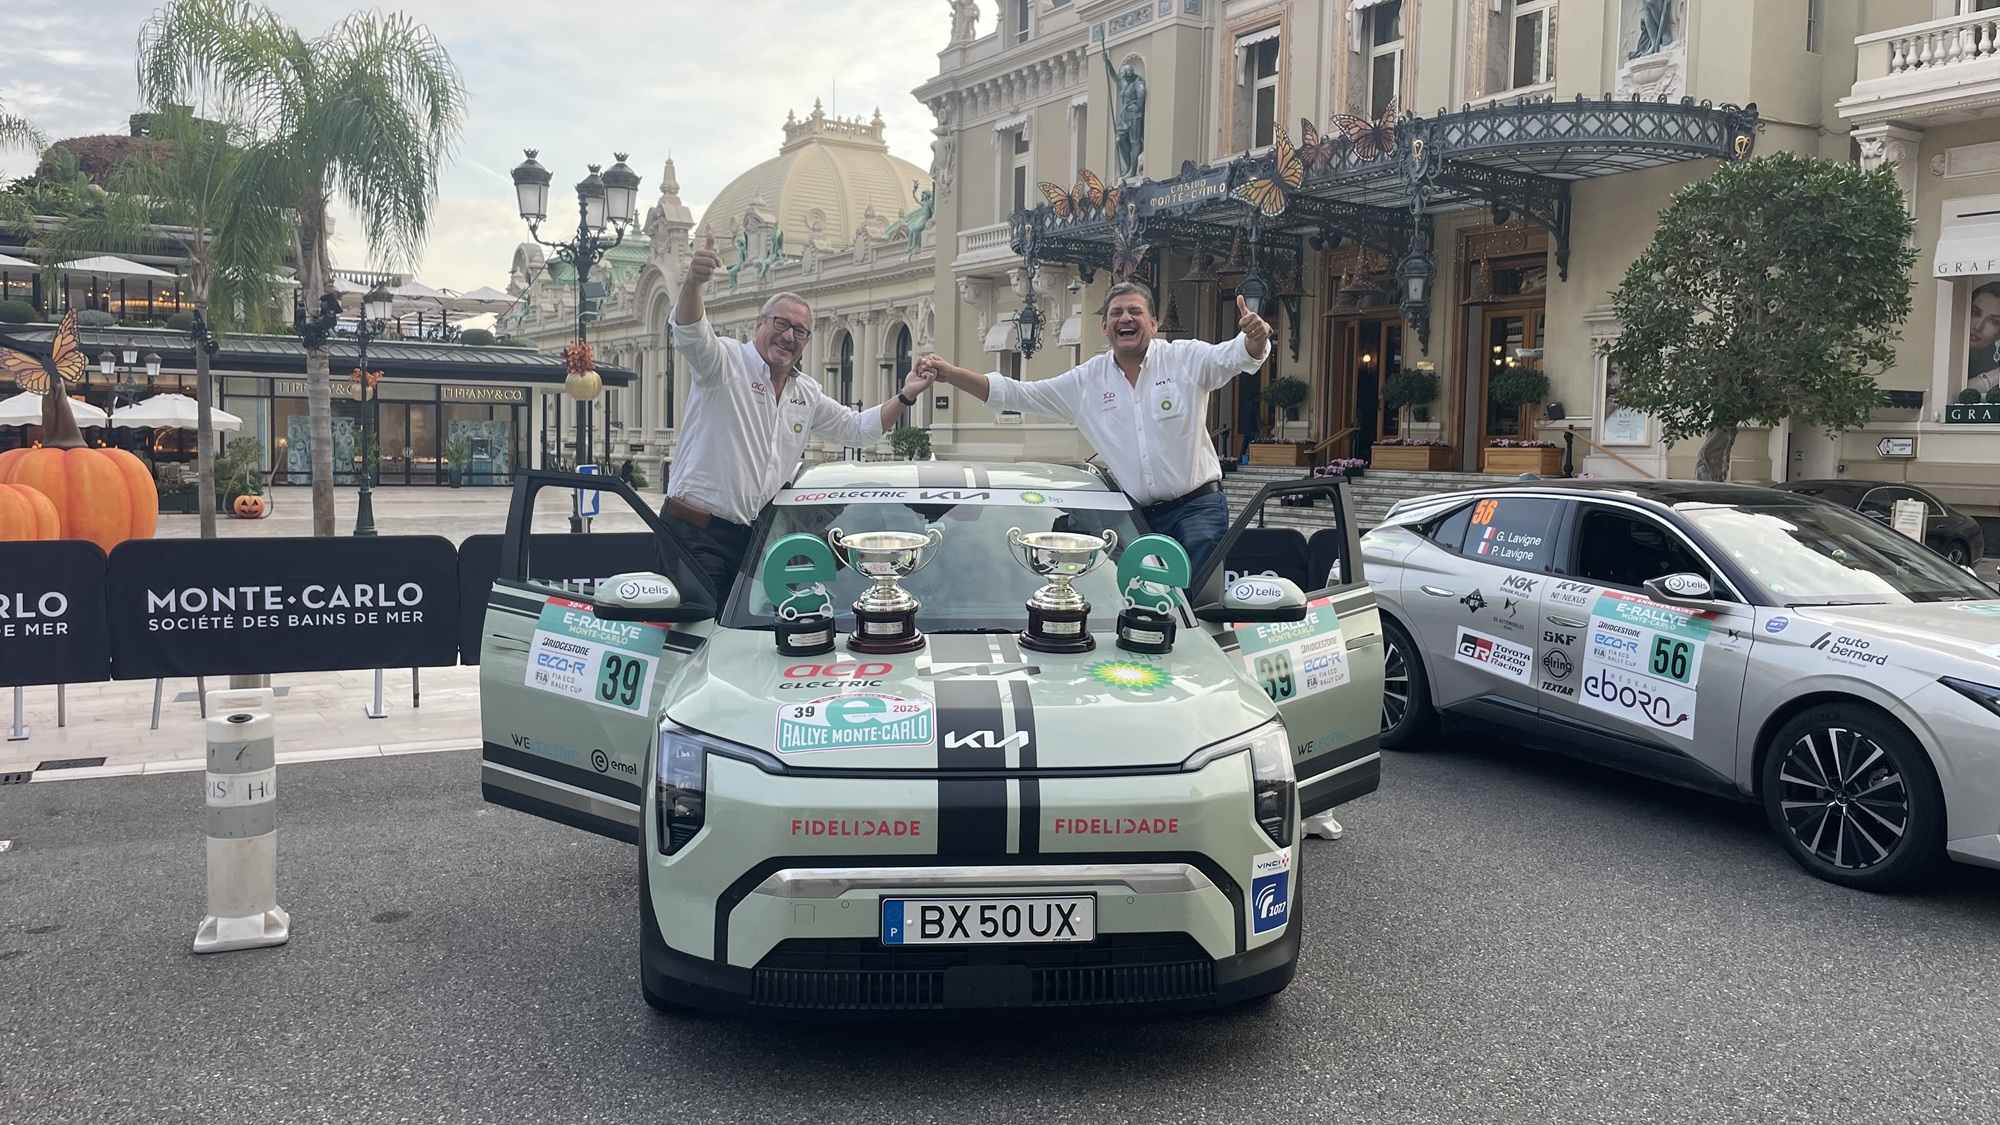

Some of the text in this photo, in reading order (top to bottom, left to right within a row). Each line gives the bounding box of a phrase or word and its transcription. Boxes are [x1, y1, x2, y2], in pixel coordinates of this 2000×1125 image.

[1170, 179, 1206, 194] CASINO
[1951, 409, 1992, 420] GRA
[1048, 495, 1064, 504] bp
[1471, 499, 1499, 526] 56
[1496, 531, 1542, 547] G. Lavigne
[1490, 545, 1534, 562] P. Lavigne
[642, 585, 669, 595] telis
[1502, 574, 1539, 593] NGK
[1556, 581, 1595, 594] KYB
[1686, 580, 1708, 590] telis
[1255, 587, 1282, 597] telis
[1562, 593, 1588, 605] NEXUS
[148, 611, 424, 631] SOCIÉTÉ DES BAINS DE MER
[1616, 602, 1688, 628] E-RALLYE
[1621, 612, 1677, 631] MONTE-CARLO
[25, 622, 69, 636] MER
[562, 611, 642, 639] E-RALLYE
[1597, 621, 1641, 638] BRIDGESTONE
[568, 625, 629, 645] MONTE-CARLO
[1267, 625, 1315, 645] MONTE-CARLO
[1543, 631, 1577, 646] SKF
[1837, 634, 1870, 649] auto
[542, 637, 590, 656] BRIDGESTONE
[1301, 637, 1338, 654] BRIDGESTONE
[1459, 642, 1490, 663] GR
[1495, 643, 1531, 661] TOYOTA
[1492, 651, 1526, 667] GAZOO
[1607, 656, 1637, 668] RALLY CUP
[1608, 648, 1630, 660] FIA ECO
[1653, 637, 1689, 680] 56
[1830, 643, 1889, 666] bernard
[783, 662, 893, 680] acp
[1318, 667, 1338, 678] FIA ECO
[1490, 657, 1523, 676] Racing
[1544, 656, 1572, 673] elring
[551, 672, 576, 684] FIA ECO
[602, 655, 641, 706] 39
[778, 680, 883, 690] ELECTRIC
[1259, 653, 1292, 701] 39
[1320, 673, 1345, 686] RALLY CUP
[1610, 673, 1657, 692] RÉSEAU
[550, 681, 583, 694] RALLY CUP
[1541, 681, 1575, 697] TEXTAR
[794, 706, 816, 718] 39
[892, 704, 921, 713] 2025
[782, 714, 928, 748] RALLYE MONTE-CARLO
[944, 730, 1030, 749] KIA
[610, 759, 637, 775] emel
[791, 819, 921, 836] FIDELIDADE
[1054, 818, 1179, 834] FIDELIDADE
[1256, 859, 1281, 869] VINCI
[920, 903, 1078, 939] BX 50 UX
[890, 927, 898, 938] P
